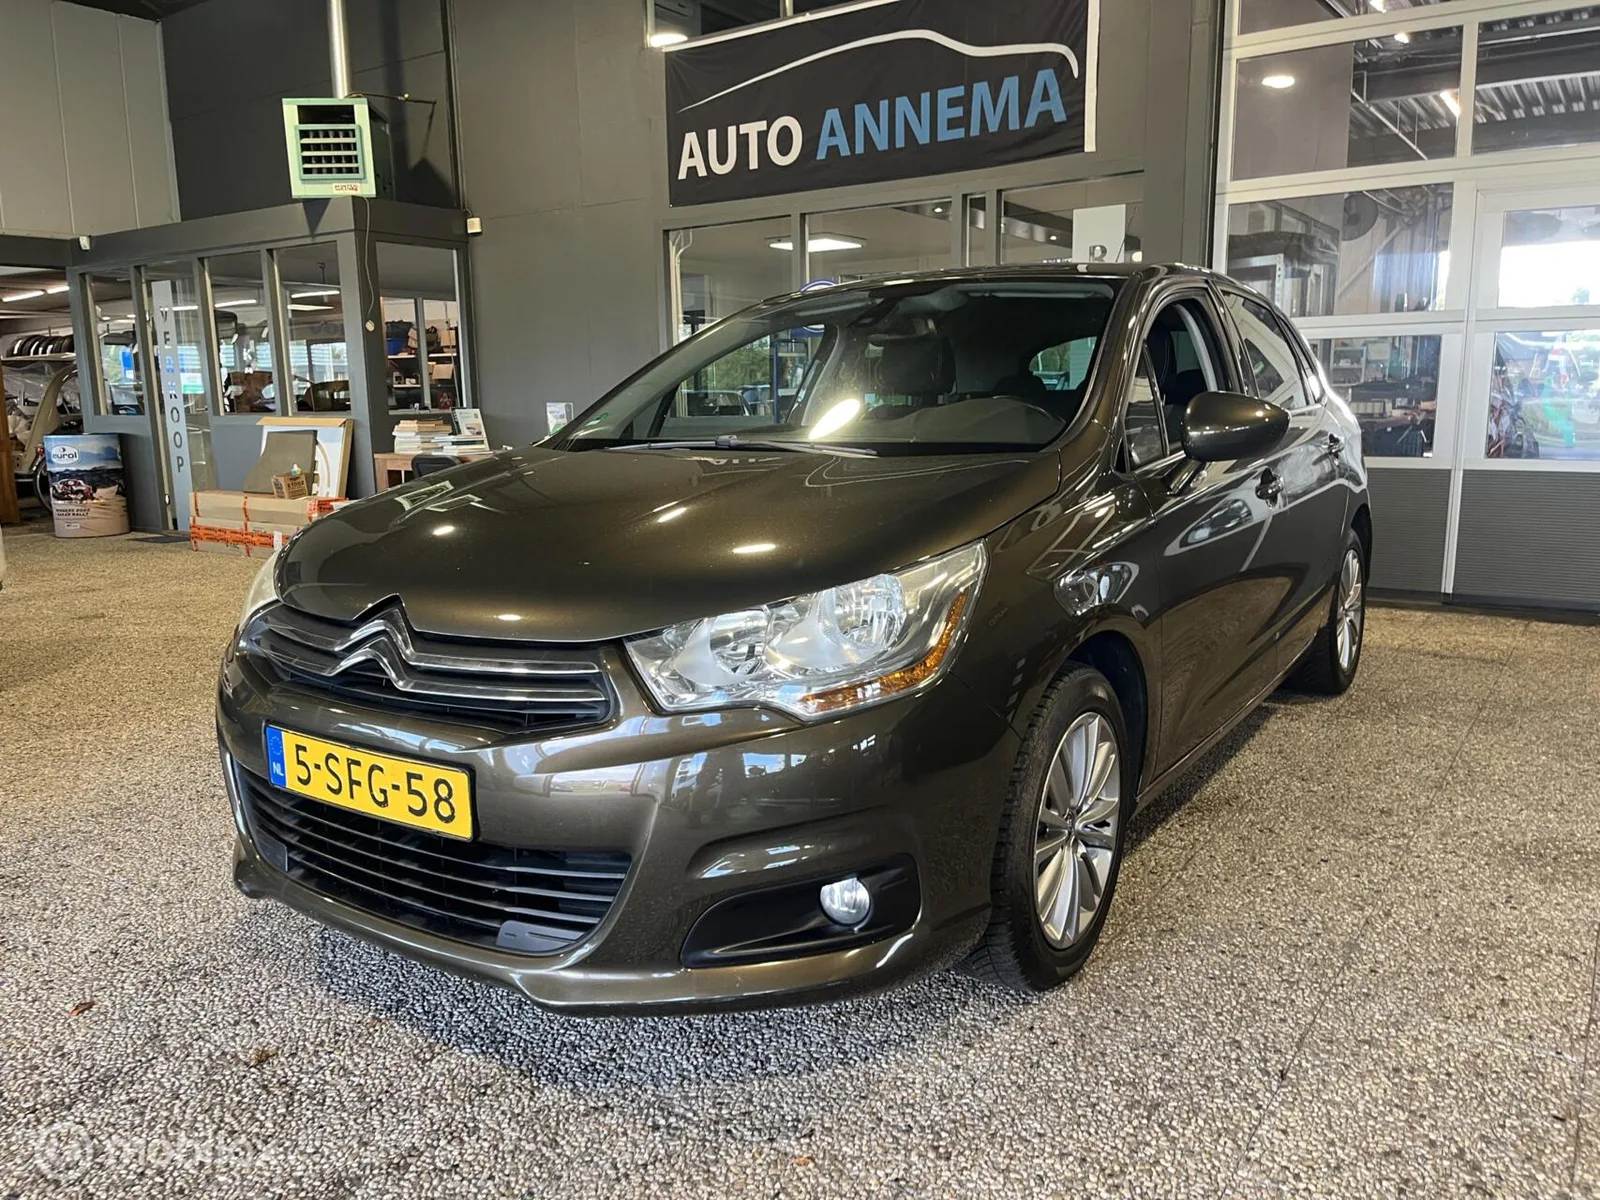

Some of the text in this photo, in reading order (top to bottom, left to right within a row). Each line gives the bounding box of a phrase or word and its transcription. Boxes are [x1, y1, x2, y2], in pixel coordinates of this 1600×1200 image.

[677, 68, 1067, 180] AUTO ANNEMA
[52, 451, 78, 459] eurol
[272, 762, 284, 776] NL
[295, 743, 456, 824] 5-SFG-58
